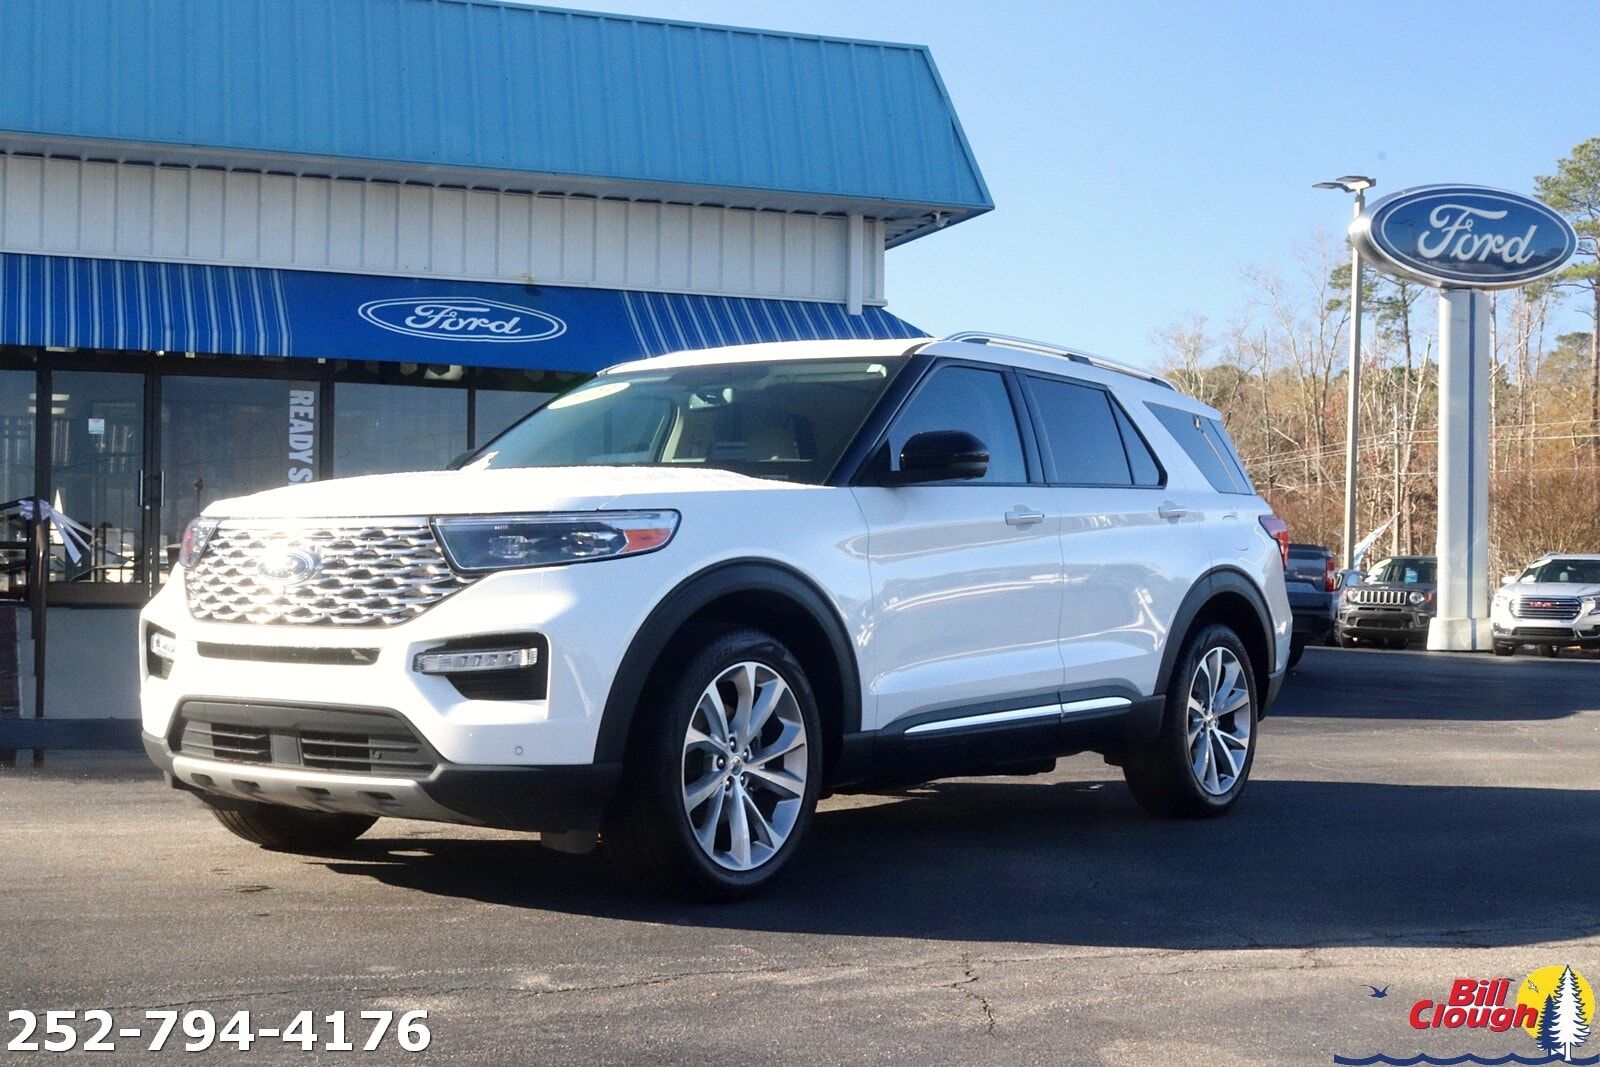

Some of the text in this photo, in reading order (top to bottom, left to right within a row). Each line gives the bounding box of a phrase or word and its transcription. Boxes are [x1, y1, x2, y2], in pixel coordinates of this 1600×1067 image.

[1418, 204, 1538, 264] Ford
[405, 304, 522, 334] Ford
[289, 390, 315, 464] READY
